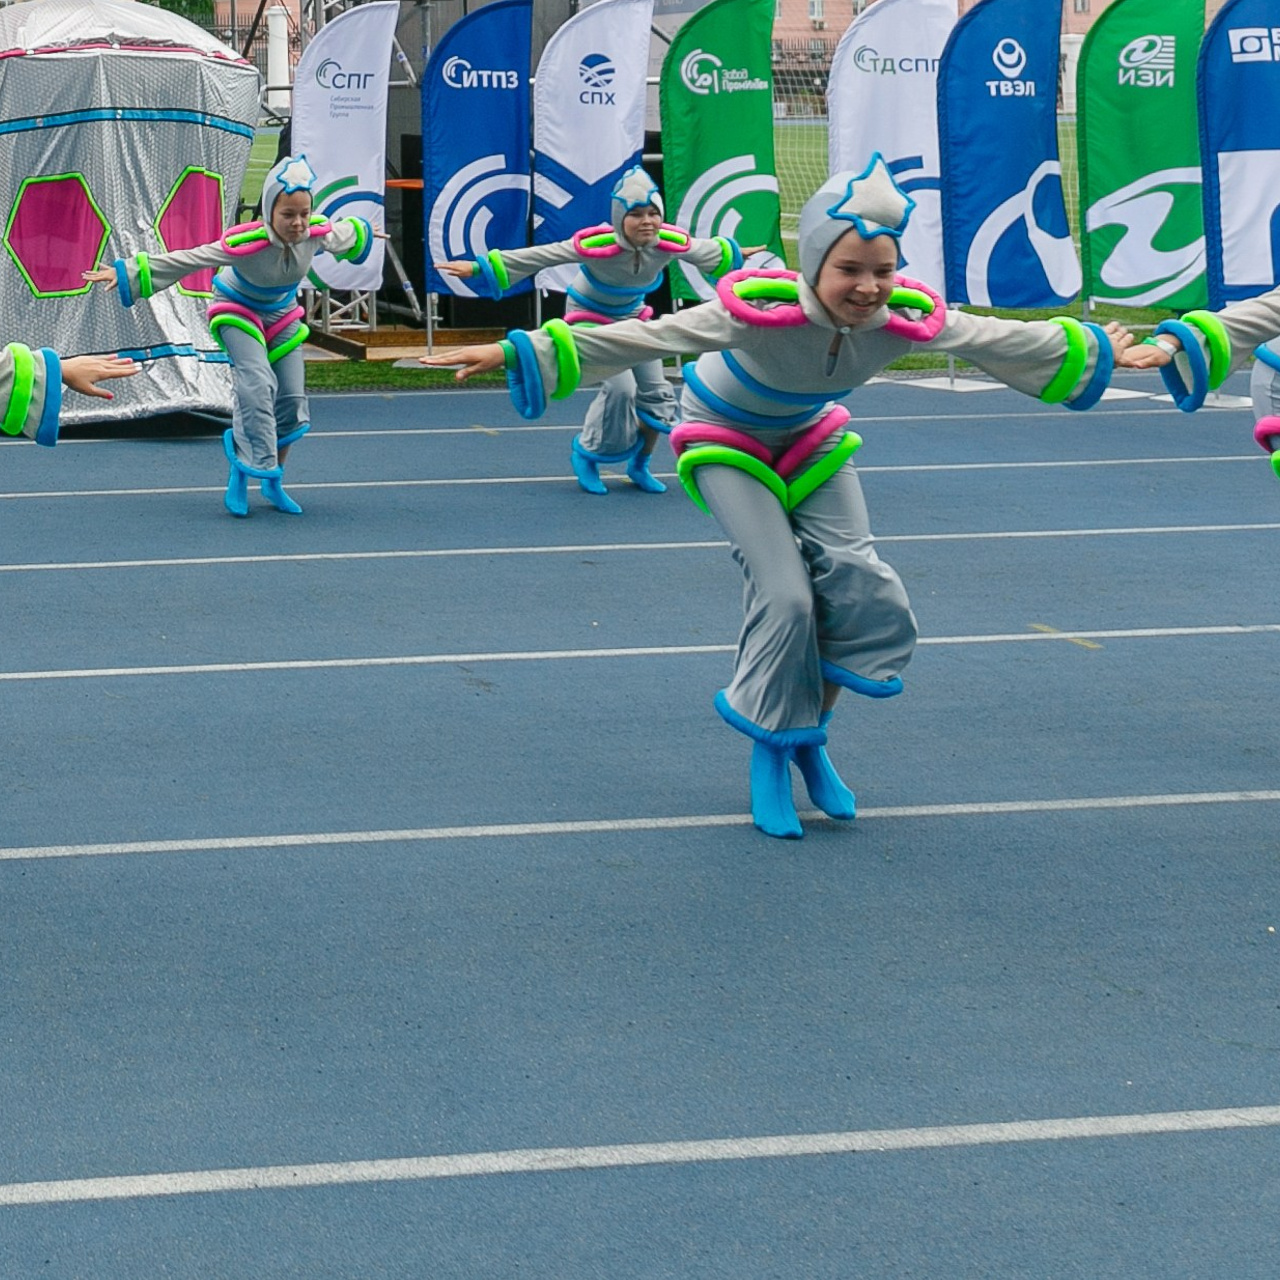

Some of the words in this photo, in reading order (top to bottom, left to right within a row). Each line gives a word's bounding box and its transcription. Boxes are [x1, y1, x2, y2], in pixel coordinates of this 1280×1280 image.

[331, 73, 375, 89] СПГ
[462, 70, 519, 89] ИТПЗ
[1118, 68, 1175, 89] ИЗИ
[985, 80, 1036, 97] ТВЭЛ
[579, 90, 616, 106] СПХ
